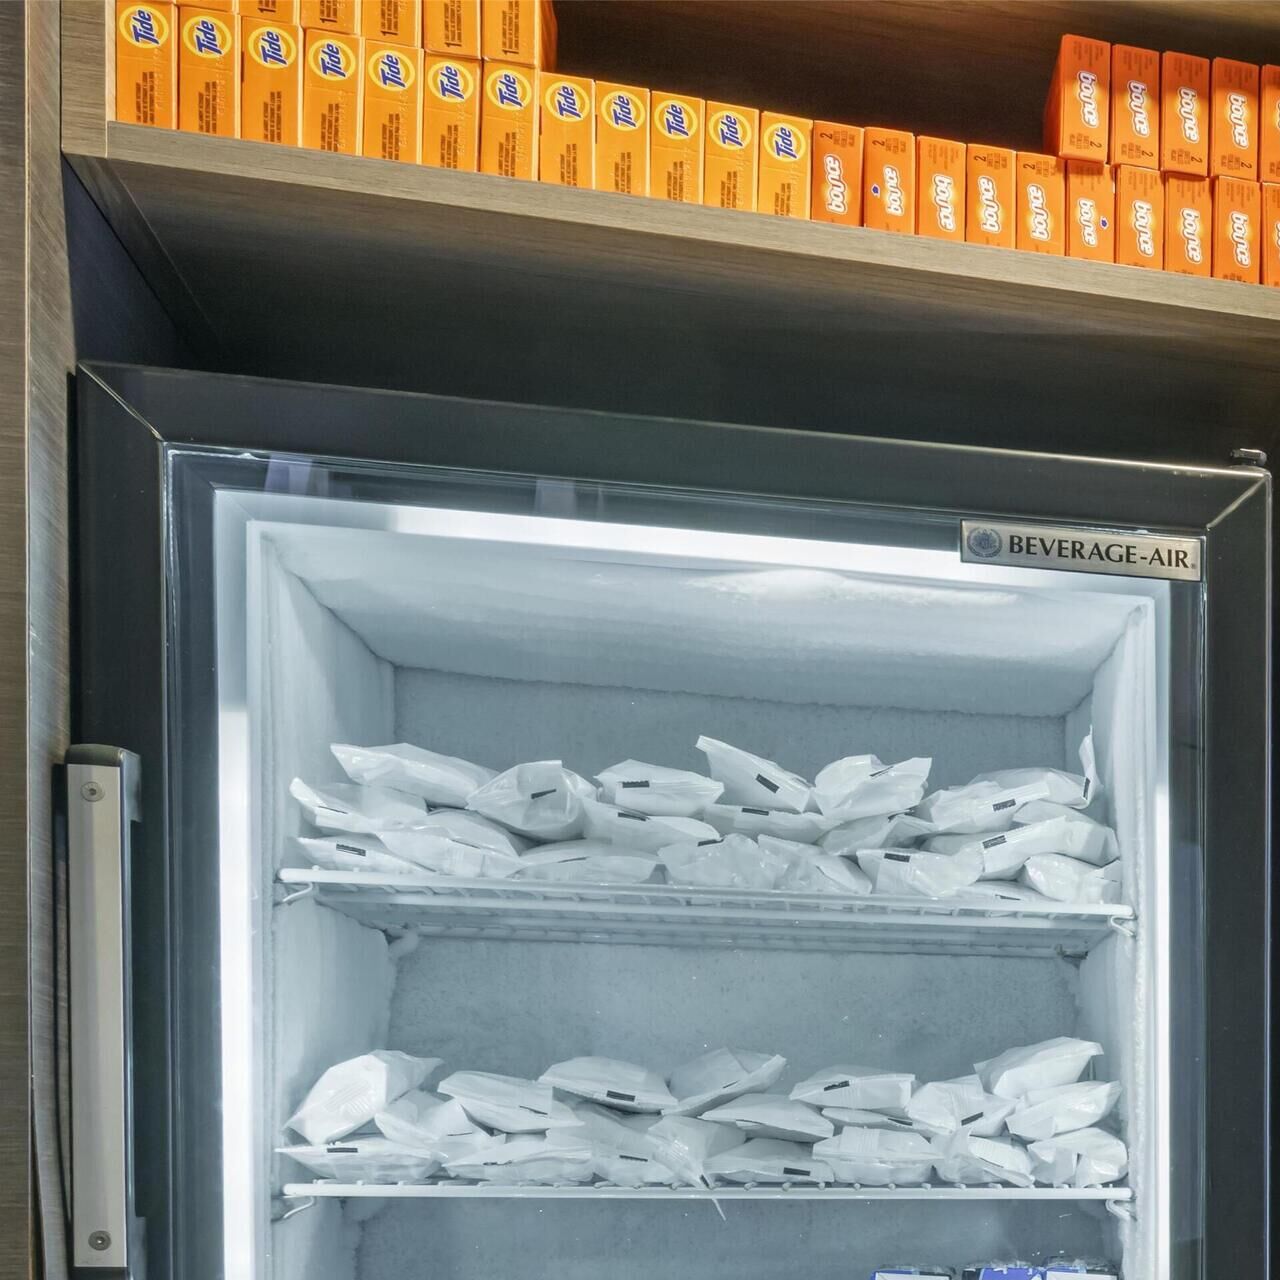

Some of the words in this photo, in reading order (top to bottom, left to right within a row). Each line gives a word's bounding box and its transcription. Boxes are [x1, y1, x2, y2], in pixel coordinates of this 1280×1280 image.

[132, 9, 160, 45] Tide
[196, 20, 222, 55] Tide
[320, 43, 346, 78] Tide
[380, 53, 406, 88] Tide
[498, 74, 523, 108] Tide
[556, 85, 581, 119] Tide
[1078, 71, 1099, 128] bounce
[613, 94, 637, 128] Tide
[1178, 87, 1199, 143] bounce
[720, 114, 743, 147] Tide
[774, 127, 797, 159] Tide
[824, 154, 848, 214] bounce
[884, 165, 904, 216] bounce
[932, 175, 956, 231] bounce
[978, 176, 1000, 233] bounce
[1027, 184, 1050, 241] bounce
[1009, 535, 1188, 569] BEVERAGE-AIR
